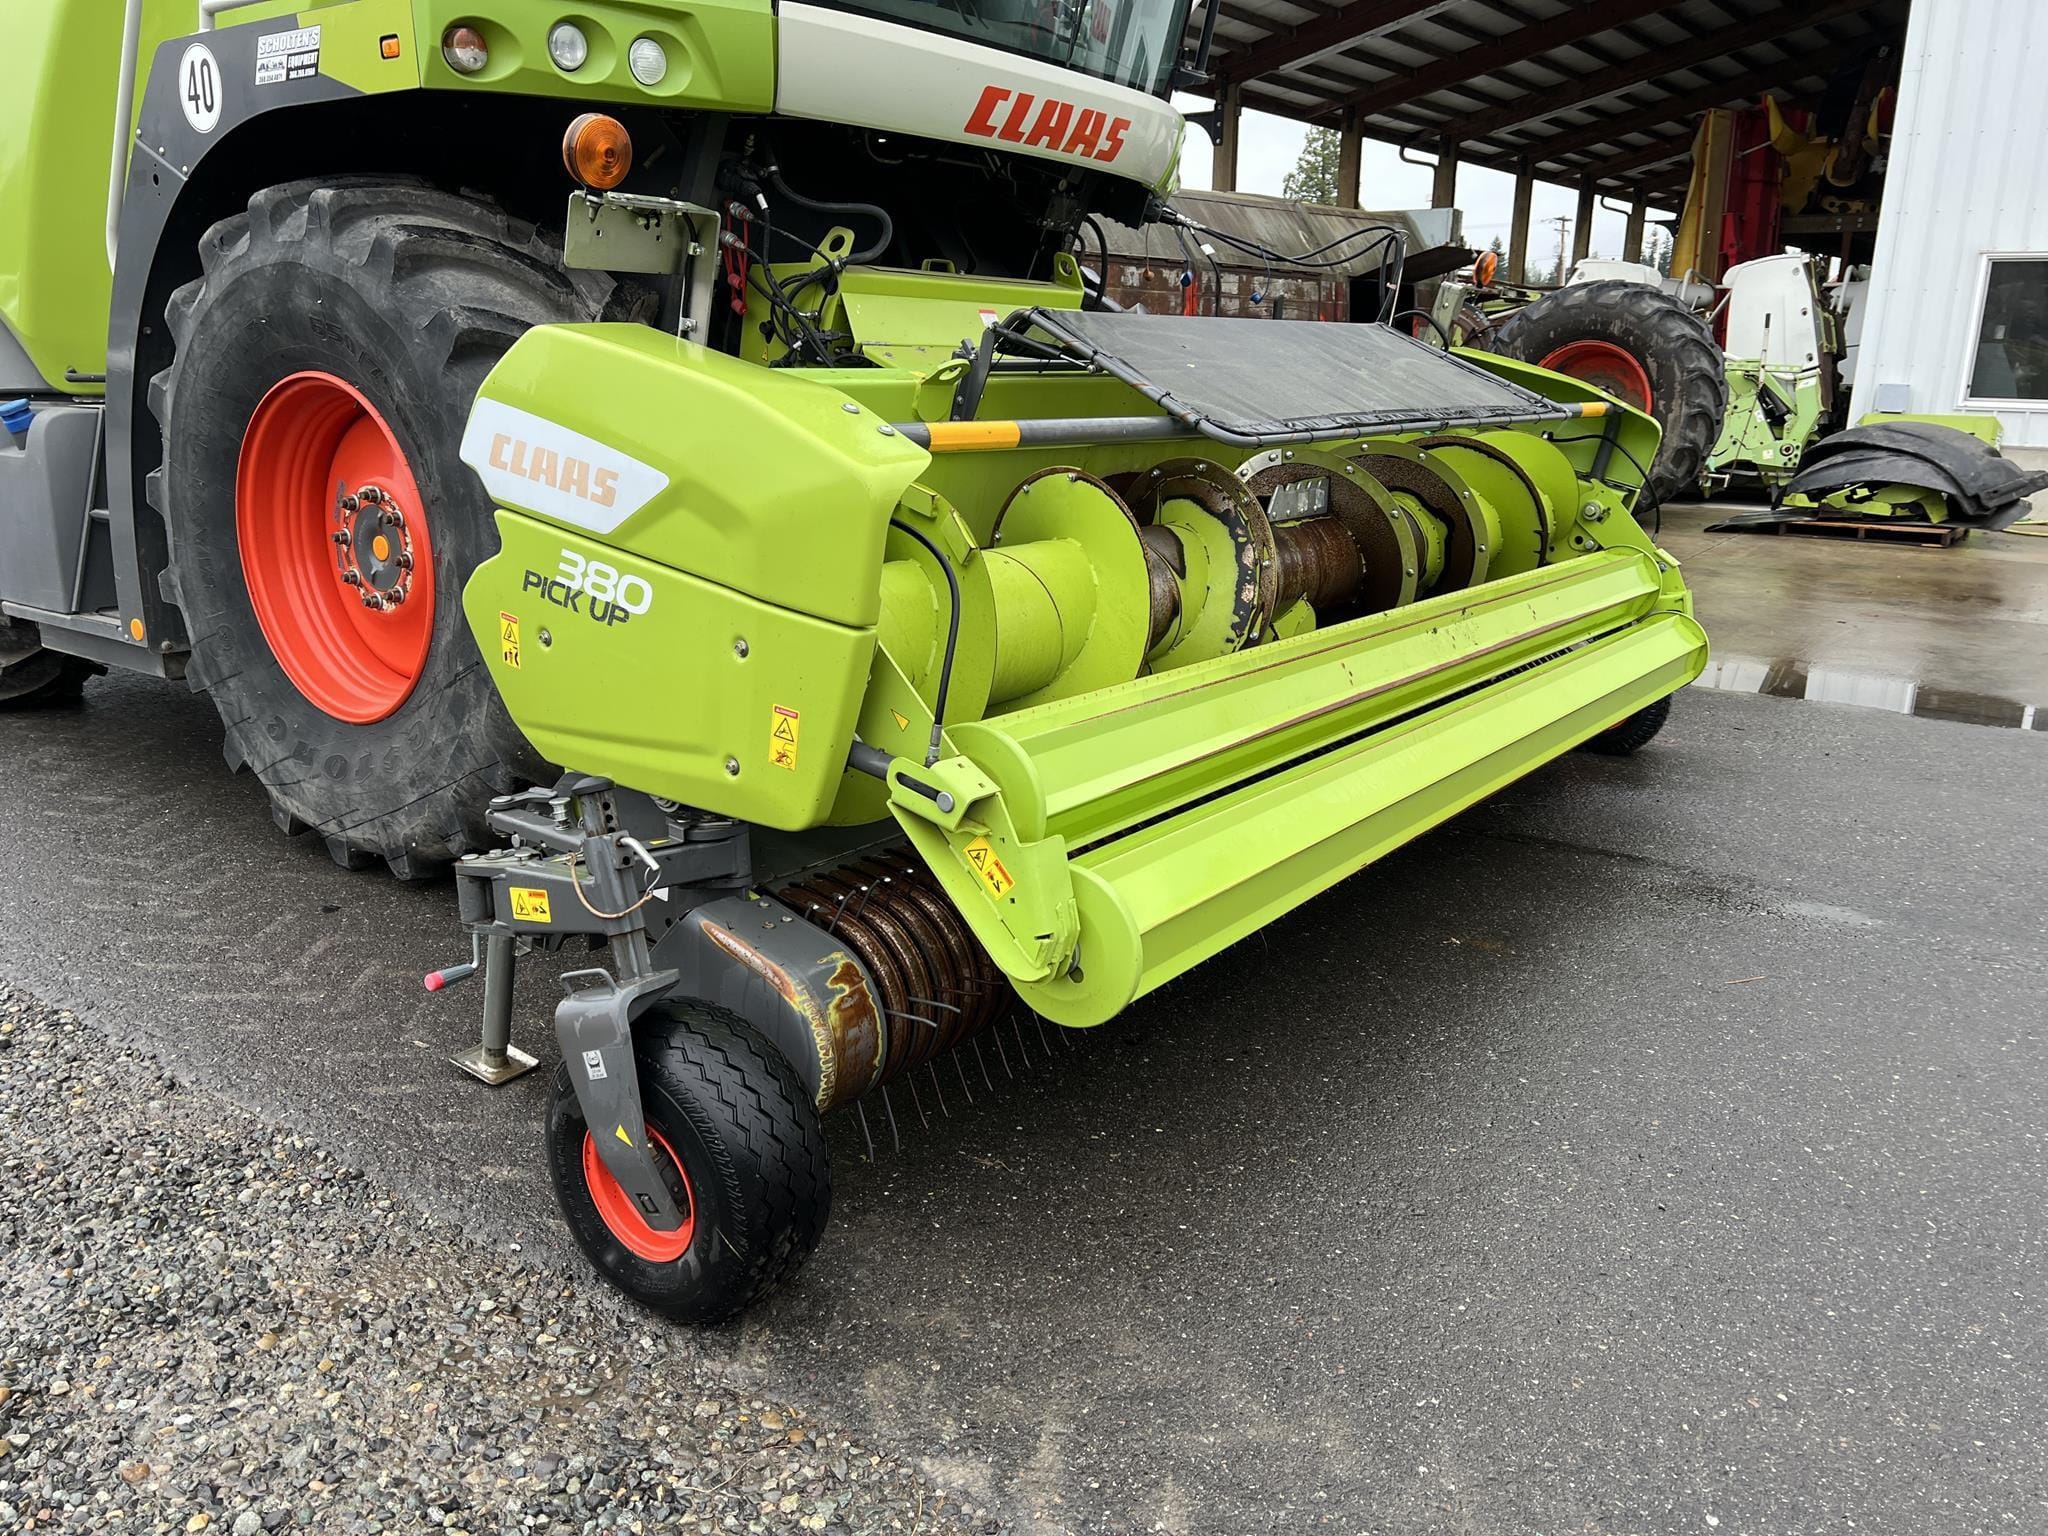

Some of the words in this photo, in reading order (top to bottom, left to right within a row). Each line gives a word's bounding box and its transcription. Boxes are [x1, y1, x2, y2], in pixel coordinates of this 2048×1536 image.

[258, 31, 319, 55] SCHOLTEN'S
[188, 58, 214, 114] 40
[964, 85, 1132, 163] CLAAS
[489, 433, 620, 508] CLAAS
[522, 569, 584, 613] PICK
[590, 595, 630, 627] UP
[555, 548, 653, 615] 380
